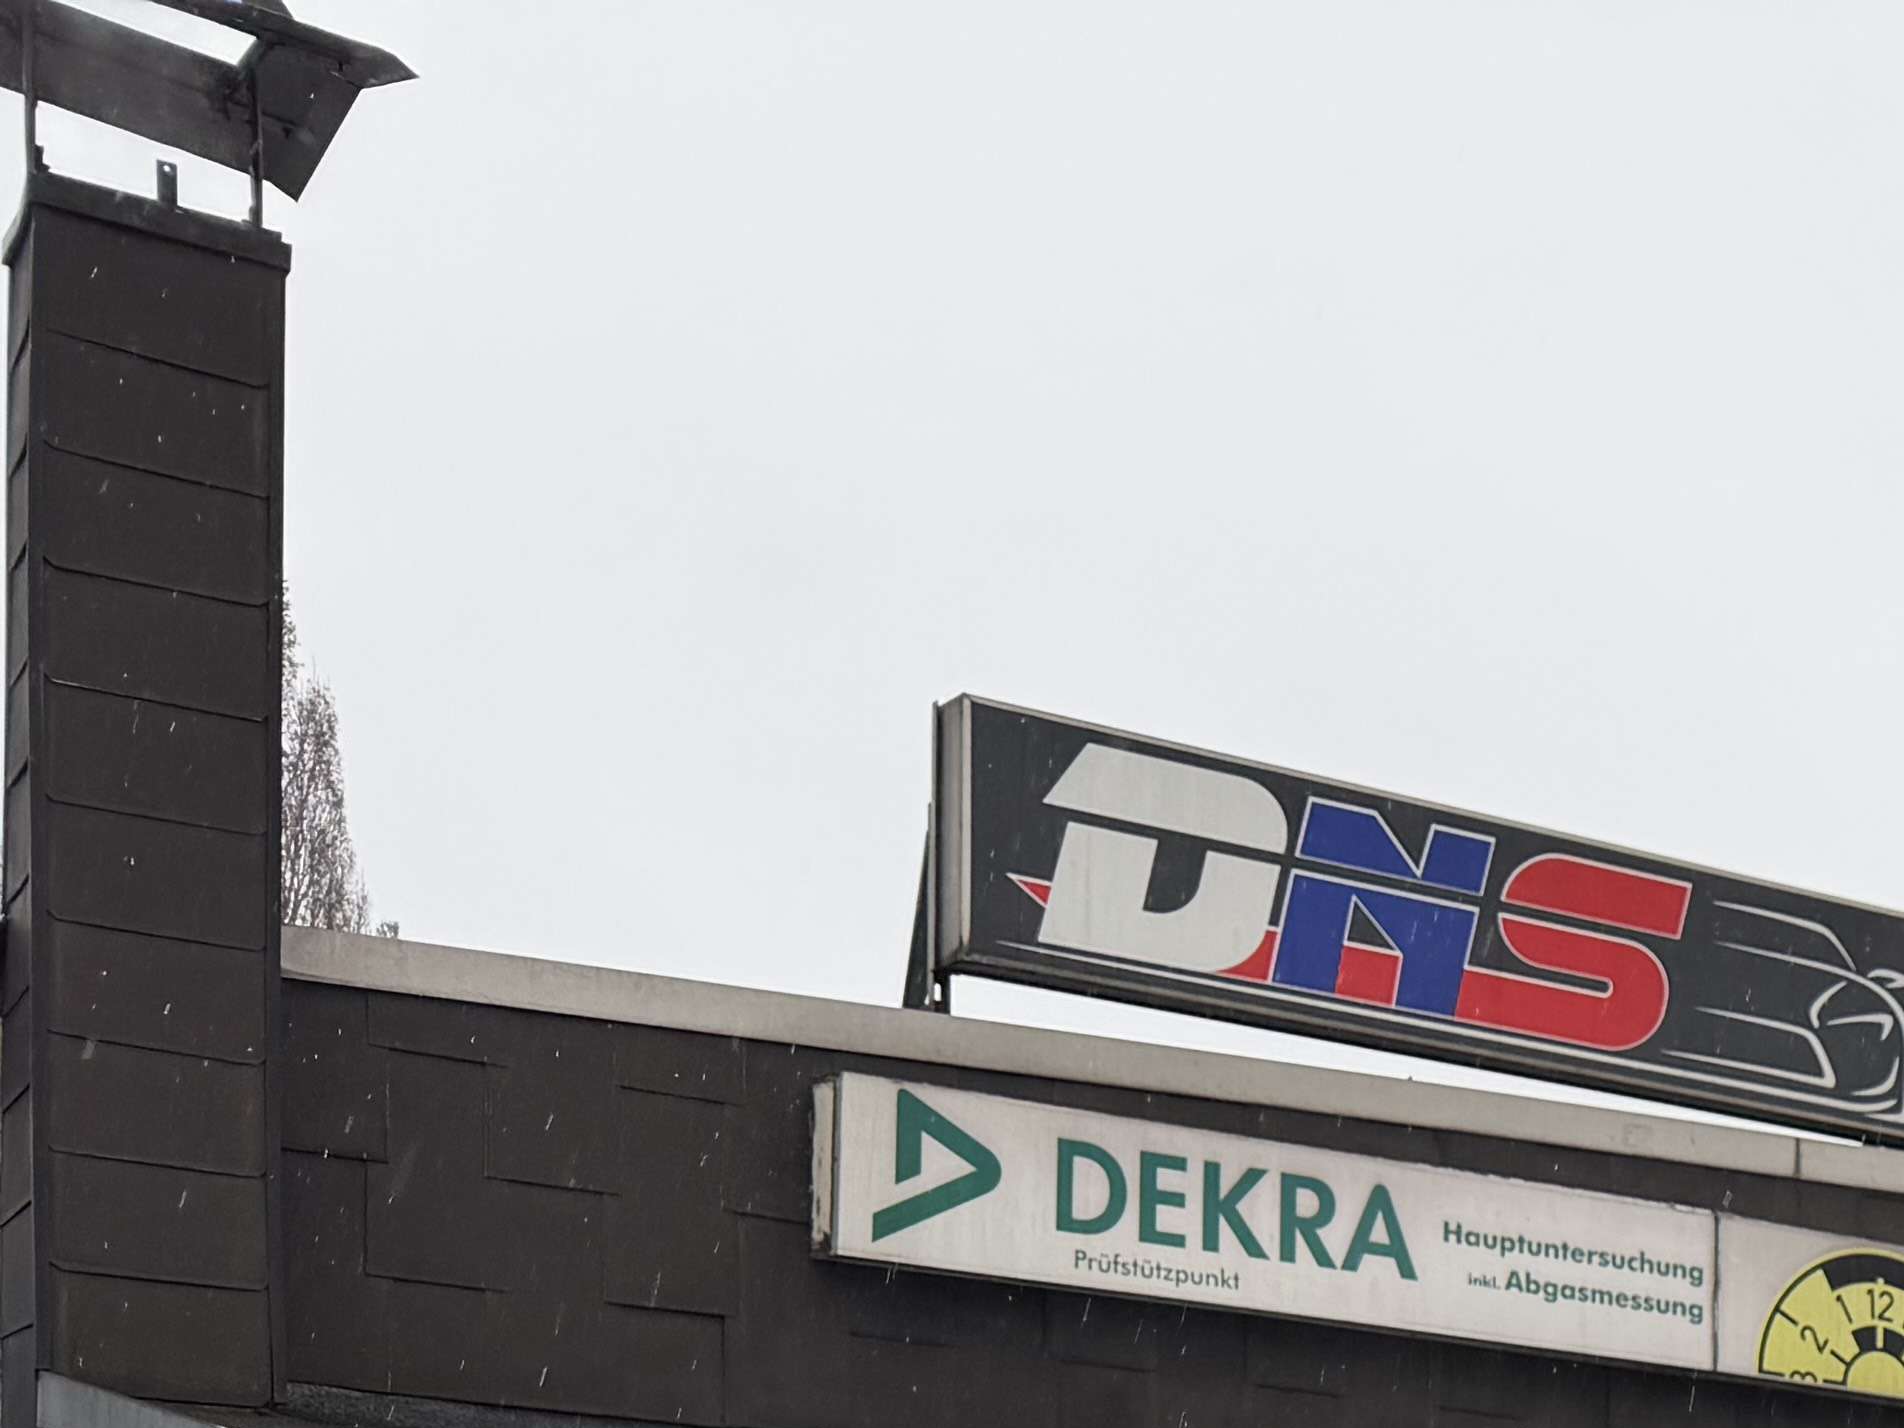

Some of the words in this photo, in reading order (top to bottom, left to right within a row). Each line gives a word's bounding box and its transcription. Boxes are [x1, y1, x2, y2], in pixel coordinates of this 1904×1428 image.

[1036, 741, 1693, 1052] DNS
[1056, 1137, 1419, 1281] DEKRA
[1073, 1249, 1241, 1291] Prüfstützpunkt
[1442, 1220, 1704, 1288] Hauptuntersuchung
[1467, 1271, 1501, 1291] inkl.
[1504, 1269, 1704, 1325] Abgasmessung
[1866, 1288, 1896, 1324] 12
